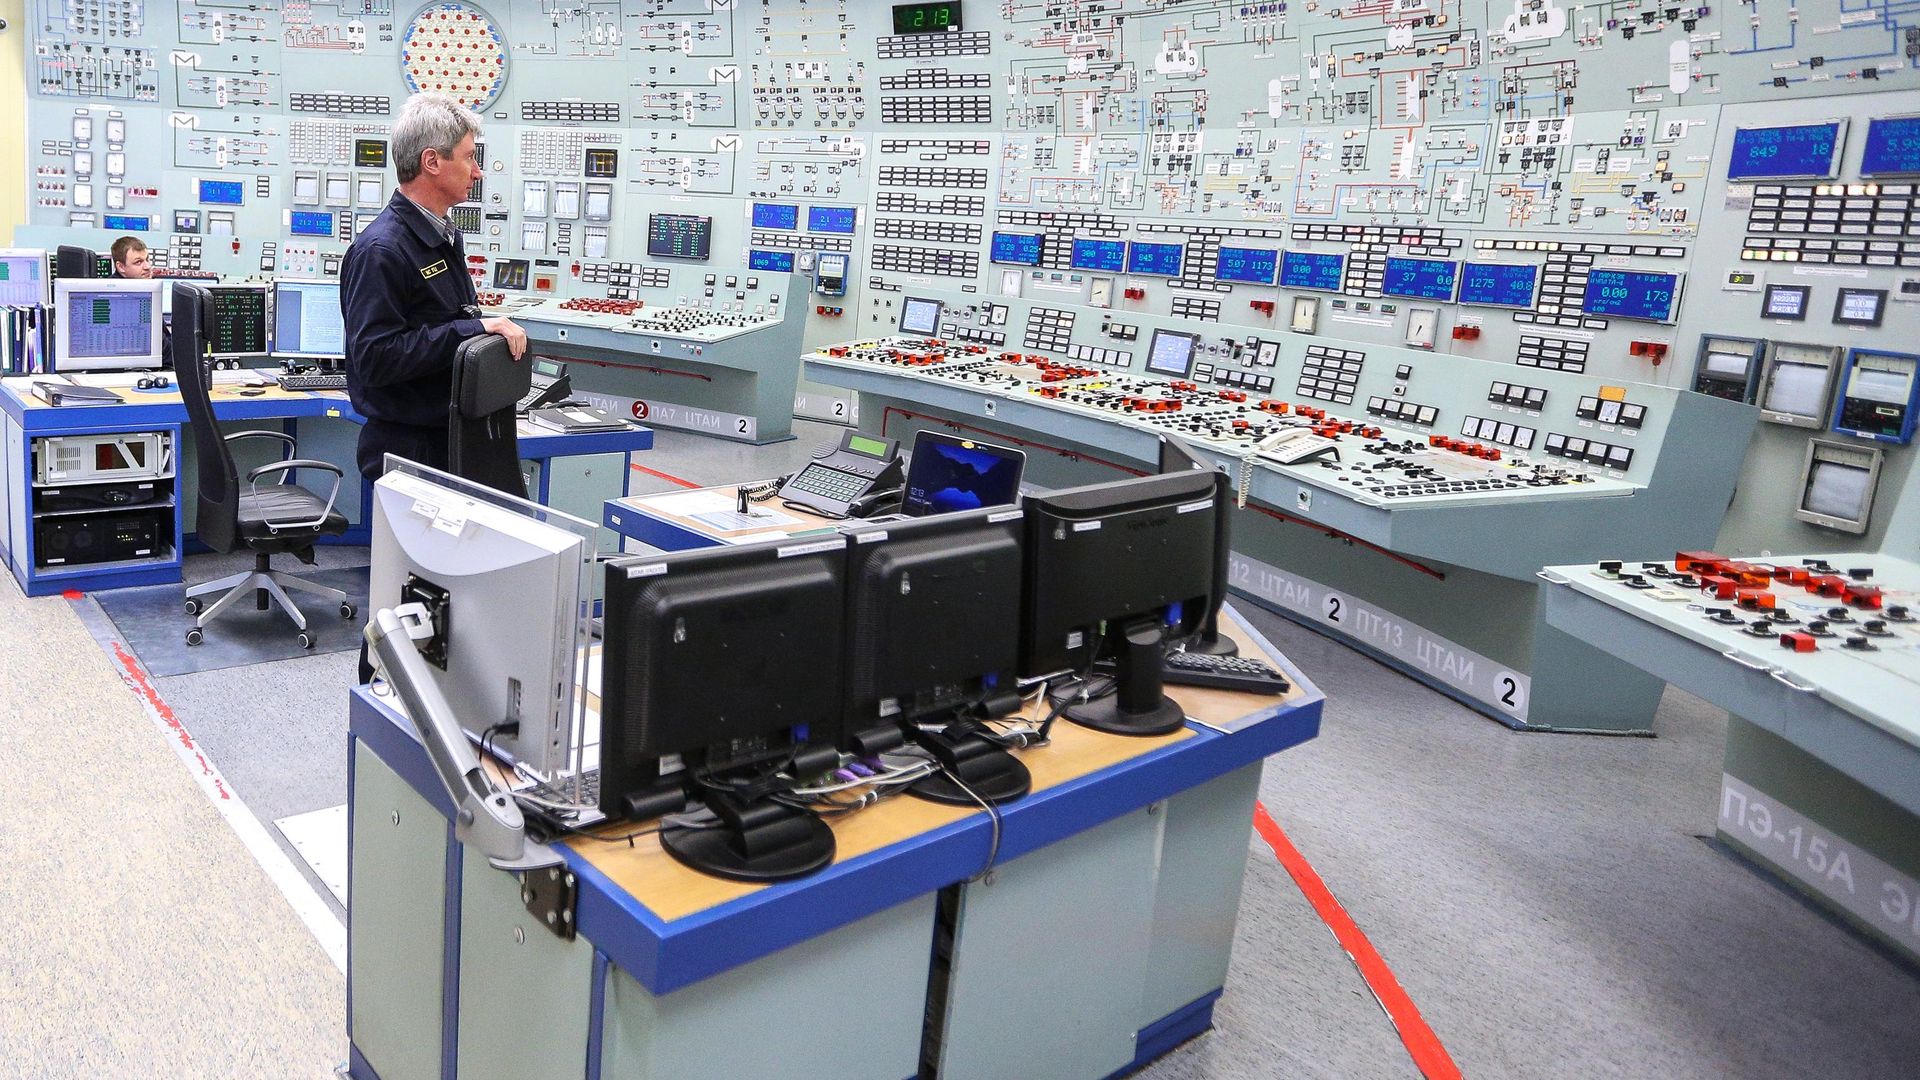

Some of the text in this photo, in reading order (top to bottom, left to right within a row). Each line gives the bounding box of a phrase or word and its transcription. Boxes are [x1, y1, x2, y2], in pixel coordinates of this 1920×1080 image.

[1508, 22, 1516, 34] 4
[1189, 57, 1195, 66] 3
[1402, 272, 1416, 282] 37
[1469, 277, 1495, 288] 1275
[1601, 287, 1669, 302] 0.00 173
[636, 404, 645, 418] 2
[834, 403, 843, 416] 2
[651, 407, 747, 433] ПА7 ЦТАИ 2
[1230, 560, 1340, 622] 12 ЦТАИ 2
[1356, 608, 1516, 707] ПТ13 ЦТАИ 2
[1723, 786, 1856, 895] ПЭ-15А
